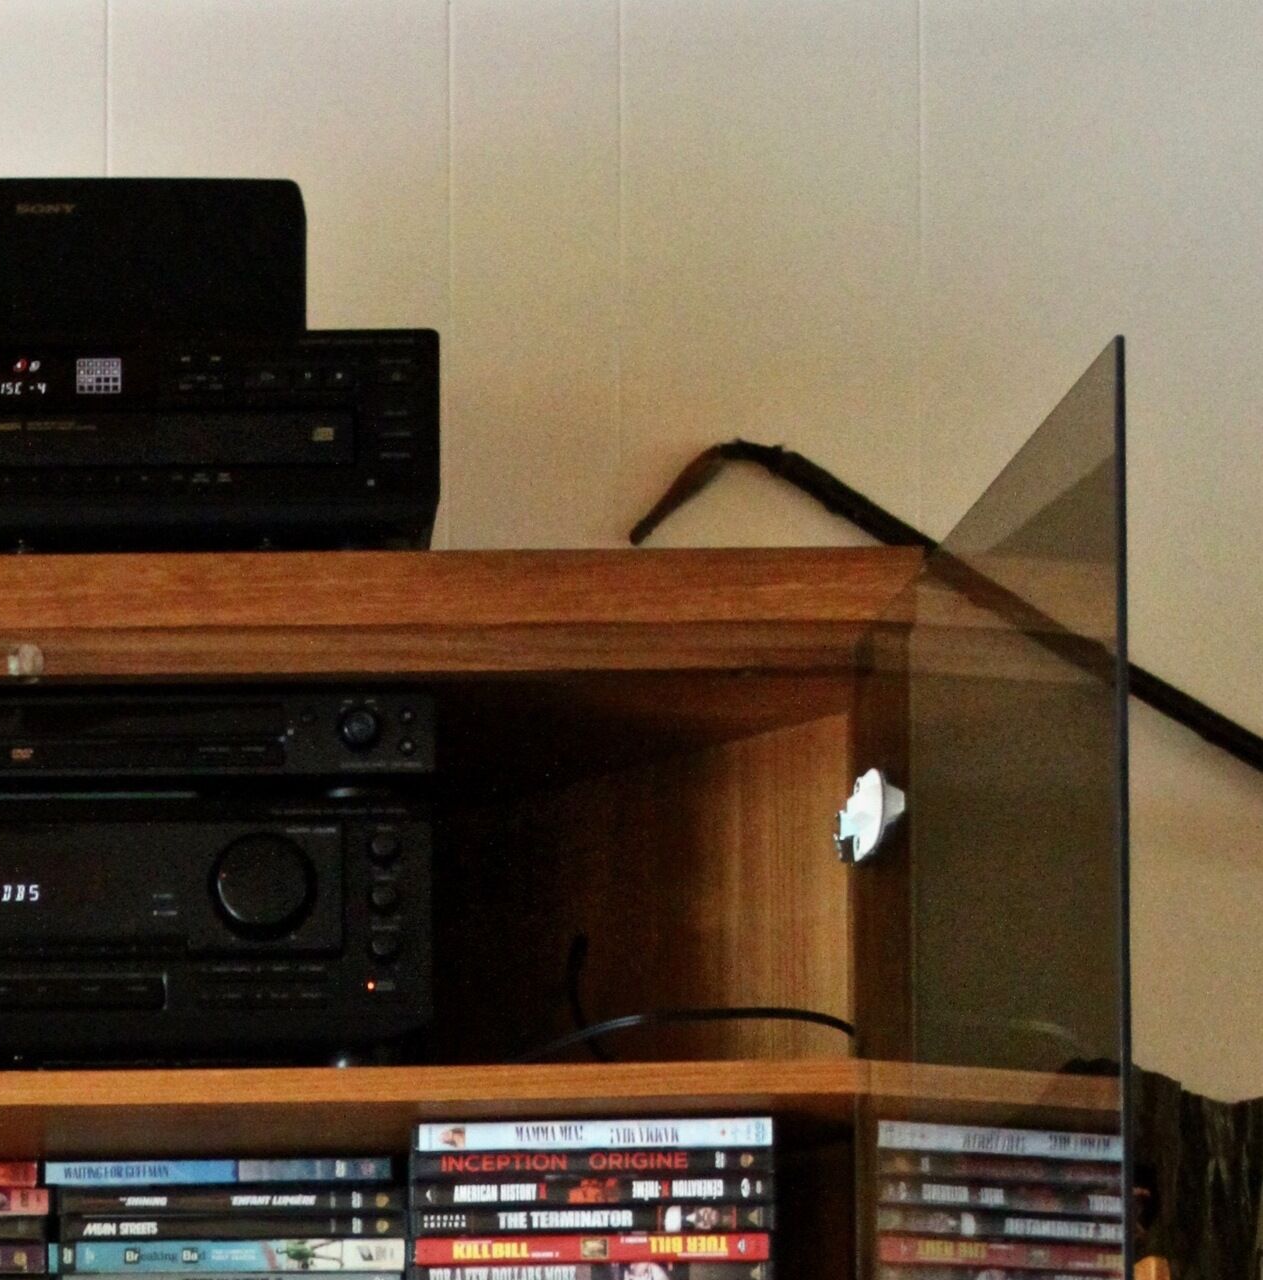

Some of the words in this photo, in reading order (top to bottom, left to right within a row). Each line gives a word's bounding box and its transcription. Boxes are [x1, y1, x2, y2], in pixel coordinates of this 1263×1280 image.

[16, 202, 76, 214] SONY
[515, 1125, 556, 1142] MAMMA
[442, 1152, 568, 1172] INCEPTION
[589, 1152, 688, 1172] ORIGINE
[454, 1184, 498, 1202] AMERICAN
[500, 1184, 536, 1202] HISTORY
[498, 1210, 536, 1229] THE
[540, 1210, 633, 1229] TERMINATOR
[453, 1242, 490, 1259] KILL
[492, 1242, 529, 1259] BILL
[650, 1236, 682, 1252] BILL
[686, 1236, 728, 1252] TUER
[124, 1249, 178, 1263] Breaking
